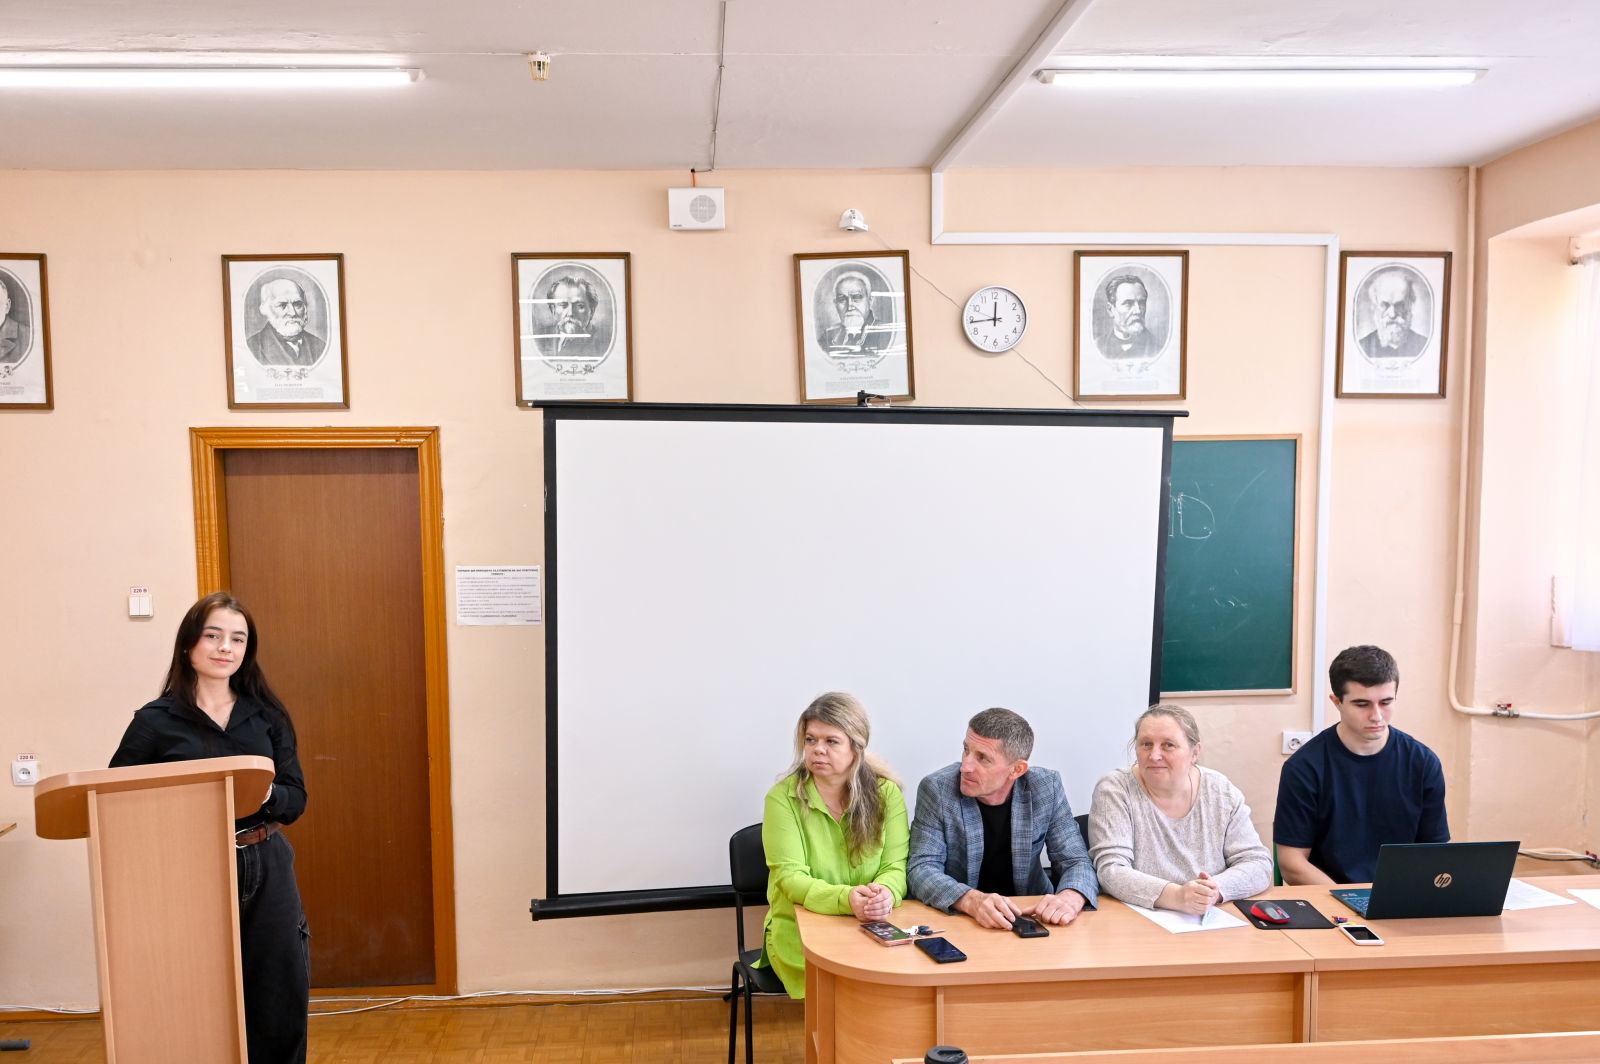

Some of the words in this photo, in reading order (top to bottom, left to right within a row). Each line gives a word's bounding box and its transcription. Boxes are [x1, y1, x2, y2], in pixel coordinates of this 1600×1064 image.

[991, 292, 999, 300] 12
[974, 304, 980, 312] 10
[1012, 302, 1016, 310] 2
[1016, 314, 1021, 322] 3
[973, 328, 978, 336] 8
[983, 336, 988, 344] 7
[993, 338, 998, 346] 6
[1004, 335, 1010, 343] 5
[1434, 872, 1452, 888] hp
